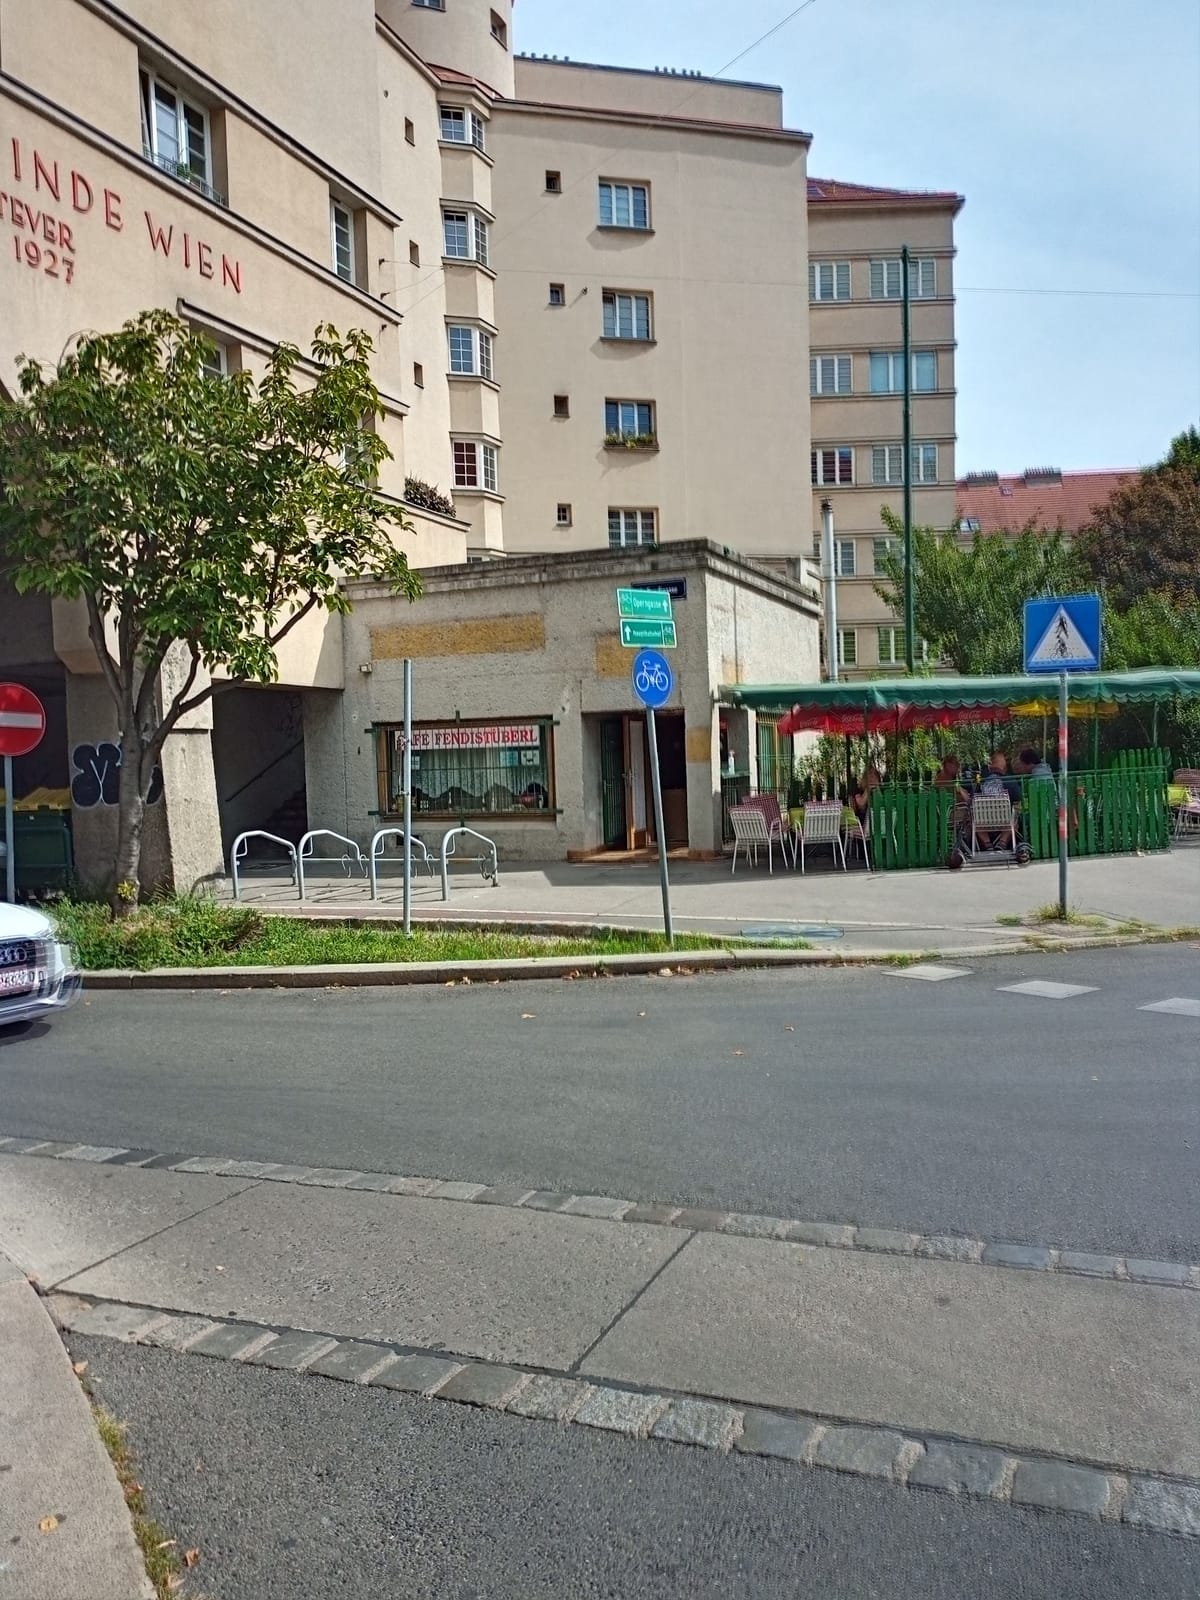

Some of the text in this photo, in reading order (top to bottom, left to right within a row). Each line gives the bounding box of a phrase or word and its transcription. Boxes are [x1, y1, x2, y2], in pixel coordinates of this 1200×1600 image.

[11, 137, 242, 293] INDE WIEN
[14, 235, 75, 284] 1927
[396, 728, 538, 748] CFE FENDISTÜBERL
